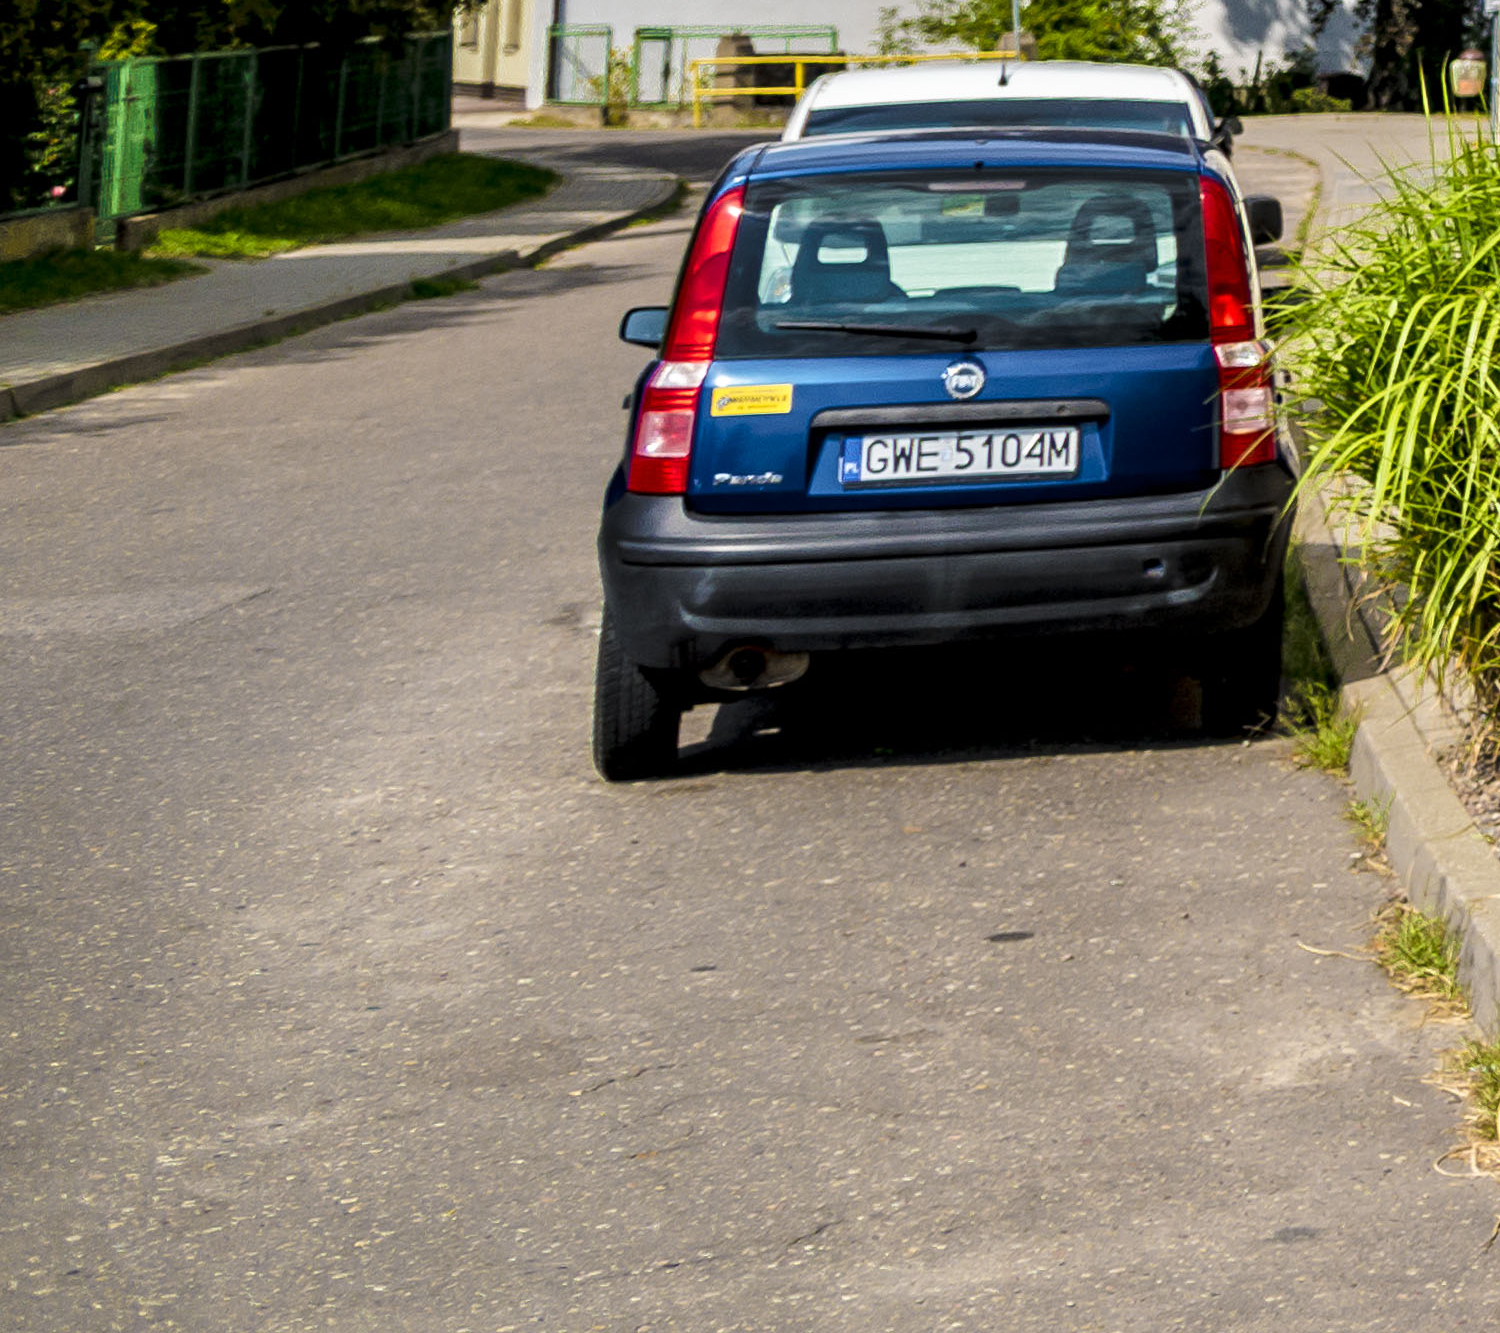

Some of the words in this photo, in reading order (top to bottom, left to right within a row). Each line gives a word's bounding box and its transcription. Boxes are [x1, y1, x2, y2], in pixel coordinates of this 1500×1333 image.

[865, 435, 939, 474] GWE
[953, 431, 1071, 471] 5104M
[712, 471, 784, 486] Panda
